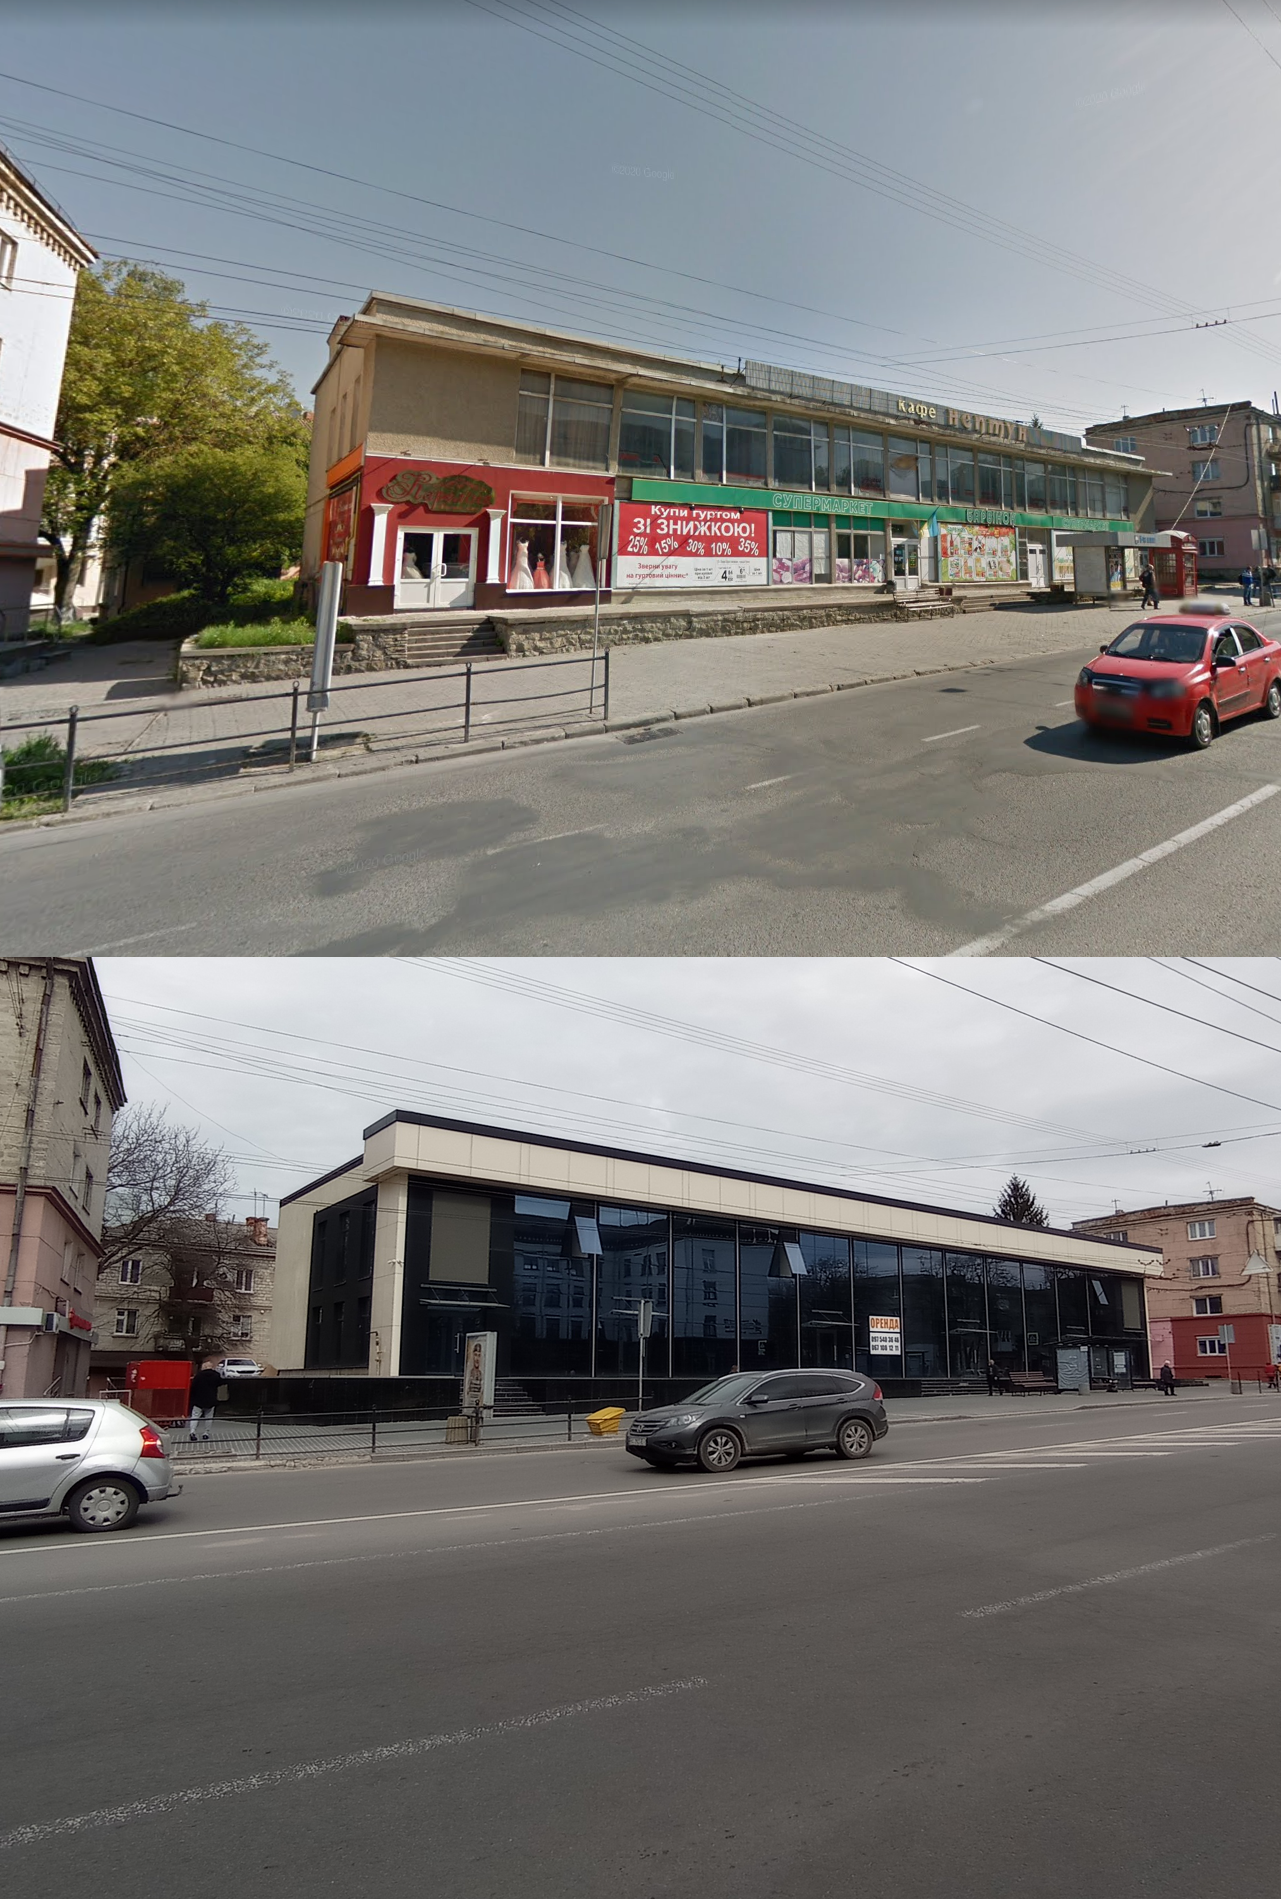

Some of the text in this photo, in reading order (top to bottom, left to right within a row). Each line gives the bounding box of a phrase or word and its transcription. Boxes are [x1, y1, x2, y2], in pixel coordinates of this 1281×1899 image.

[772, 493, 874, 515] СУПЕРМАРКЕТ
[651, 505, 741, 520] Купи гуртом
[633, 517, 755, 537] ЗІ ЗНИЖКОЮ!
[627, 535, 759, 556] 25% 15% 30% 10% 35%
[637, 562, 678, 571] Зверни увагу
[635, 572, 664, 580] гуртовий
[871, 1318, 899, 1330] ОРЕНДА
